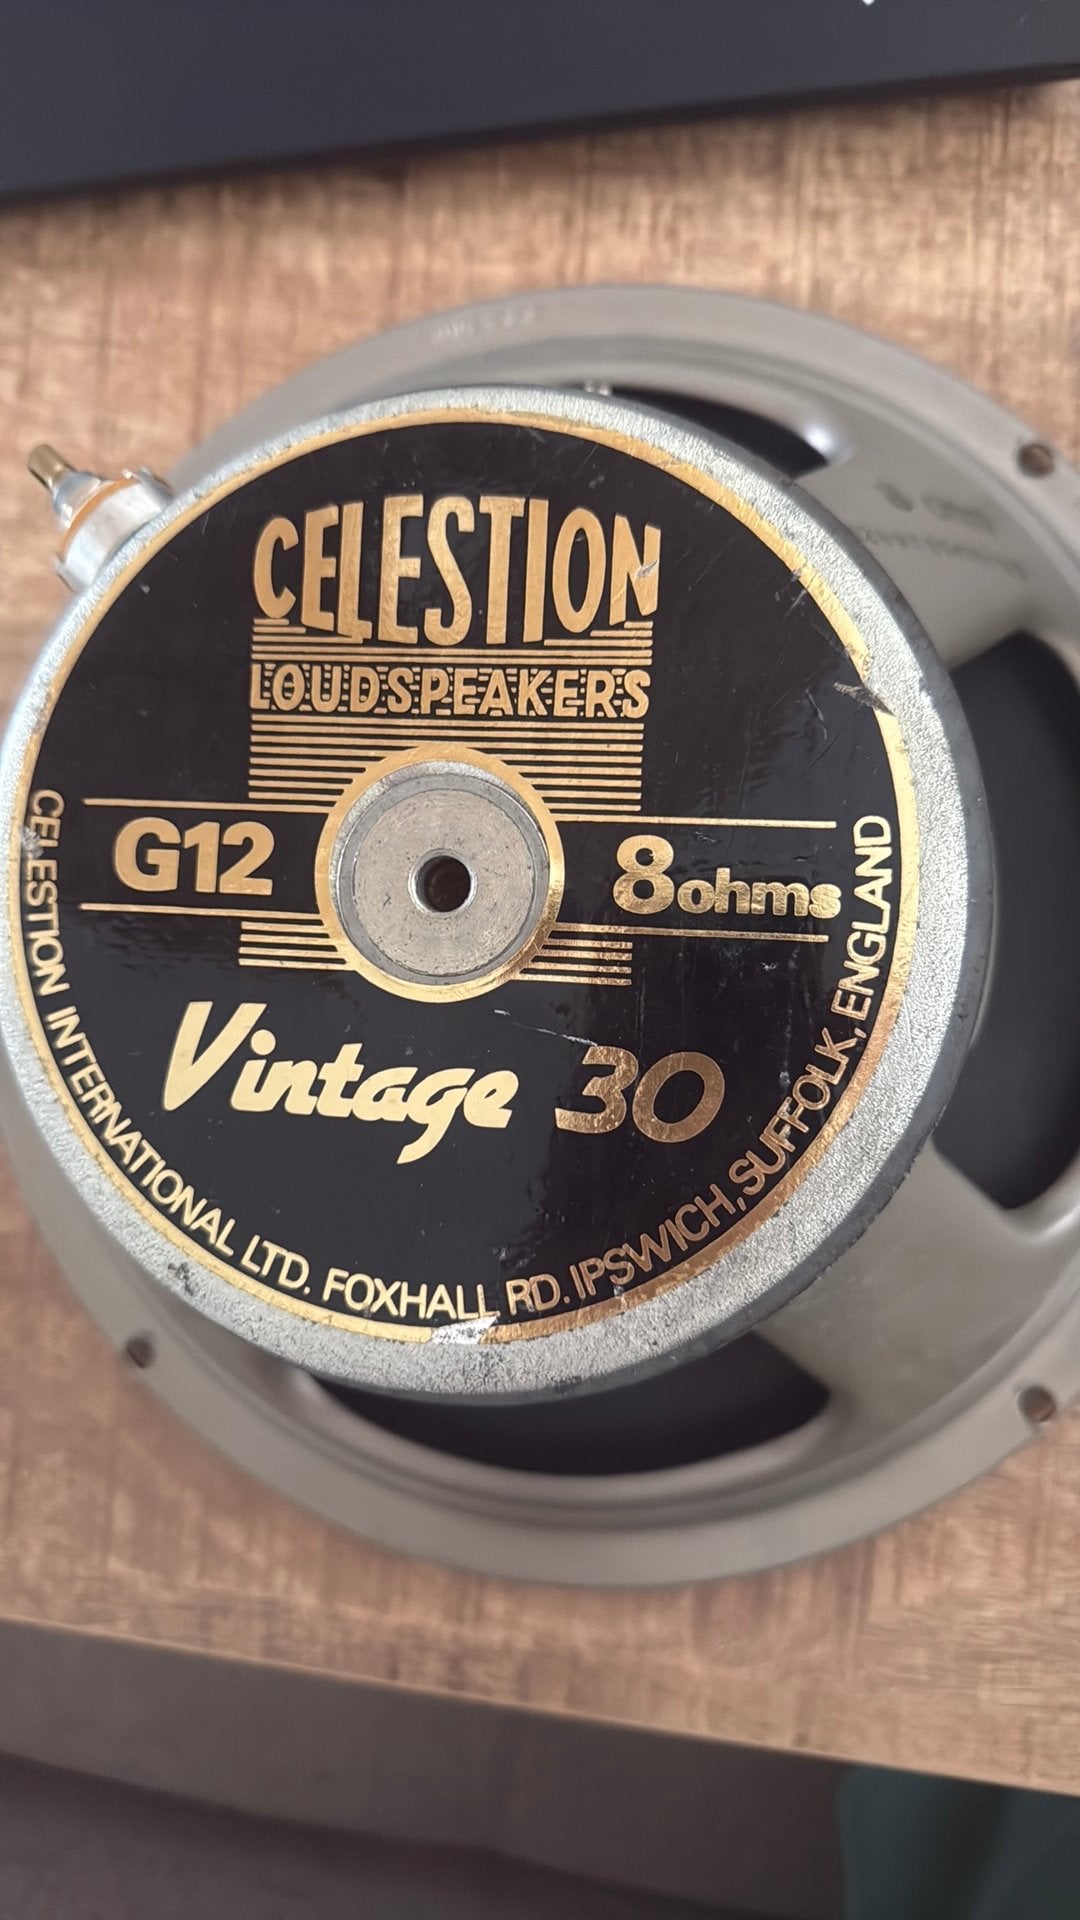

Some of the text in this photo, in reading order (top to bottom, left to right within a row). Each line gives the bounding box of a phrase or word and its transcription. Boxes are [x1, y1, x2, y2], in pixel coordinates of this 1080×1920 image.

[253, 494, 661, 646] CELESTION
[250, 663, 651, 718] LOUDSPEAKERS
[113, 817, 274, 896] G12
[47, 1006, 235, 1257] INTERNATIONAL
[240, 1235, 311, 1295] LTD.
[322, 1268, 500, 1320] FOXHALL
[506, 1273, 570, 1316] RD.
[570, 1183, 747, 1299] IPSWICH,
[728, 1027, 868, 1197] SUFFOLK,
[830, 814, 893, 1018] ENGLAND
[163, 1001, 725, 1164] Vintage 30
